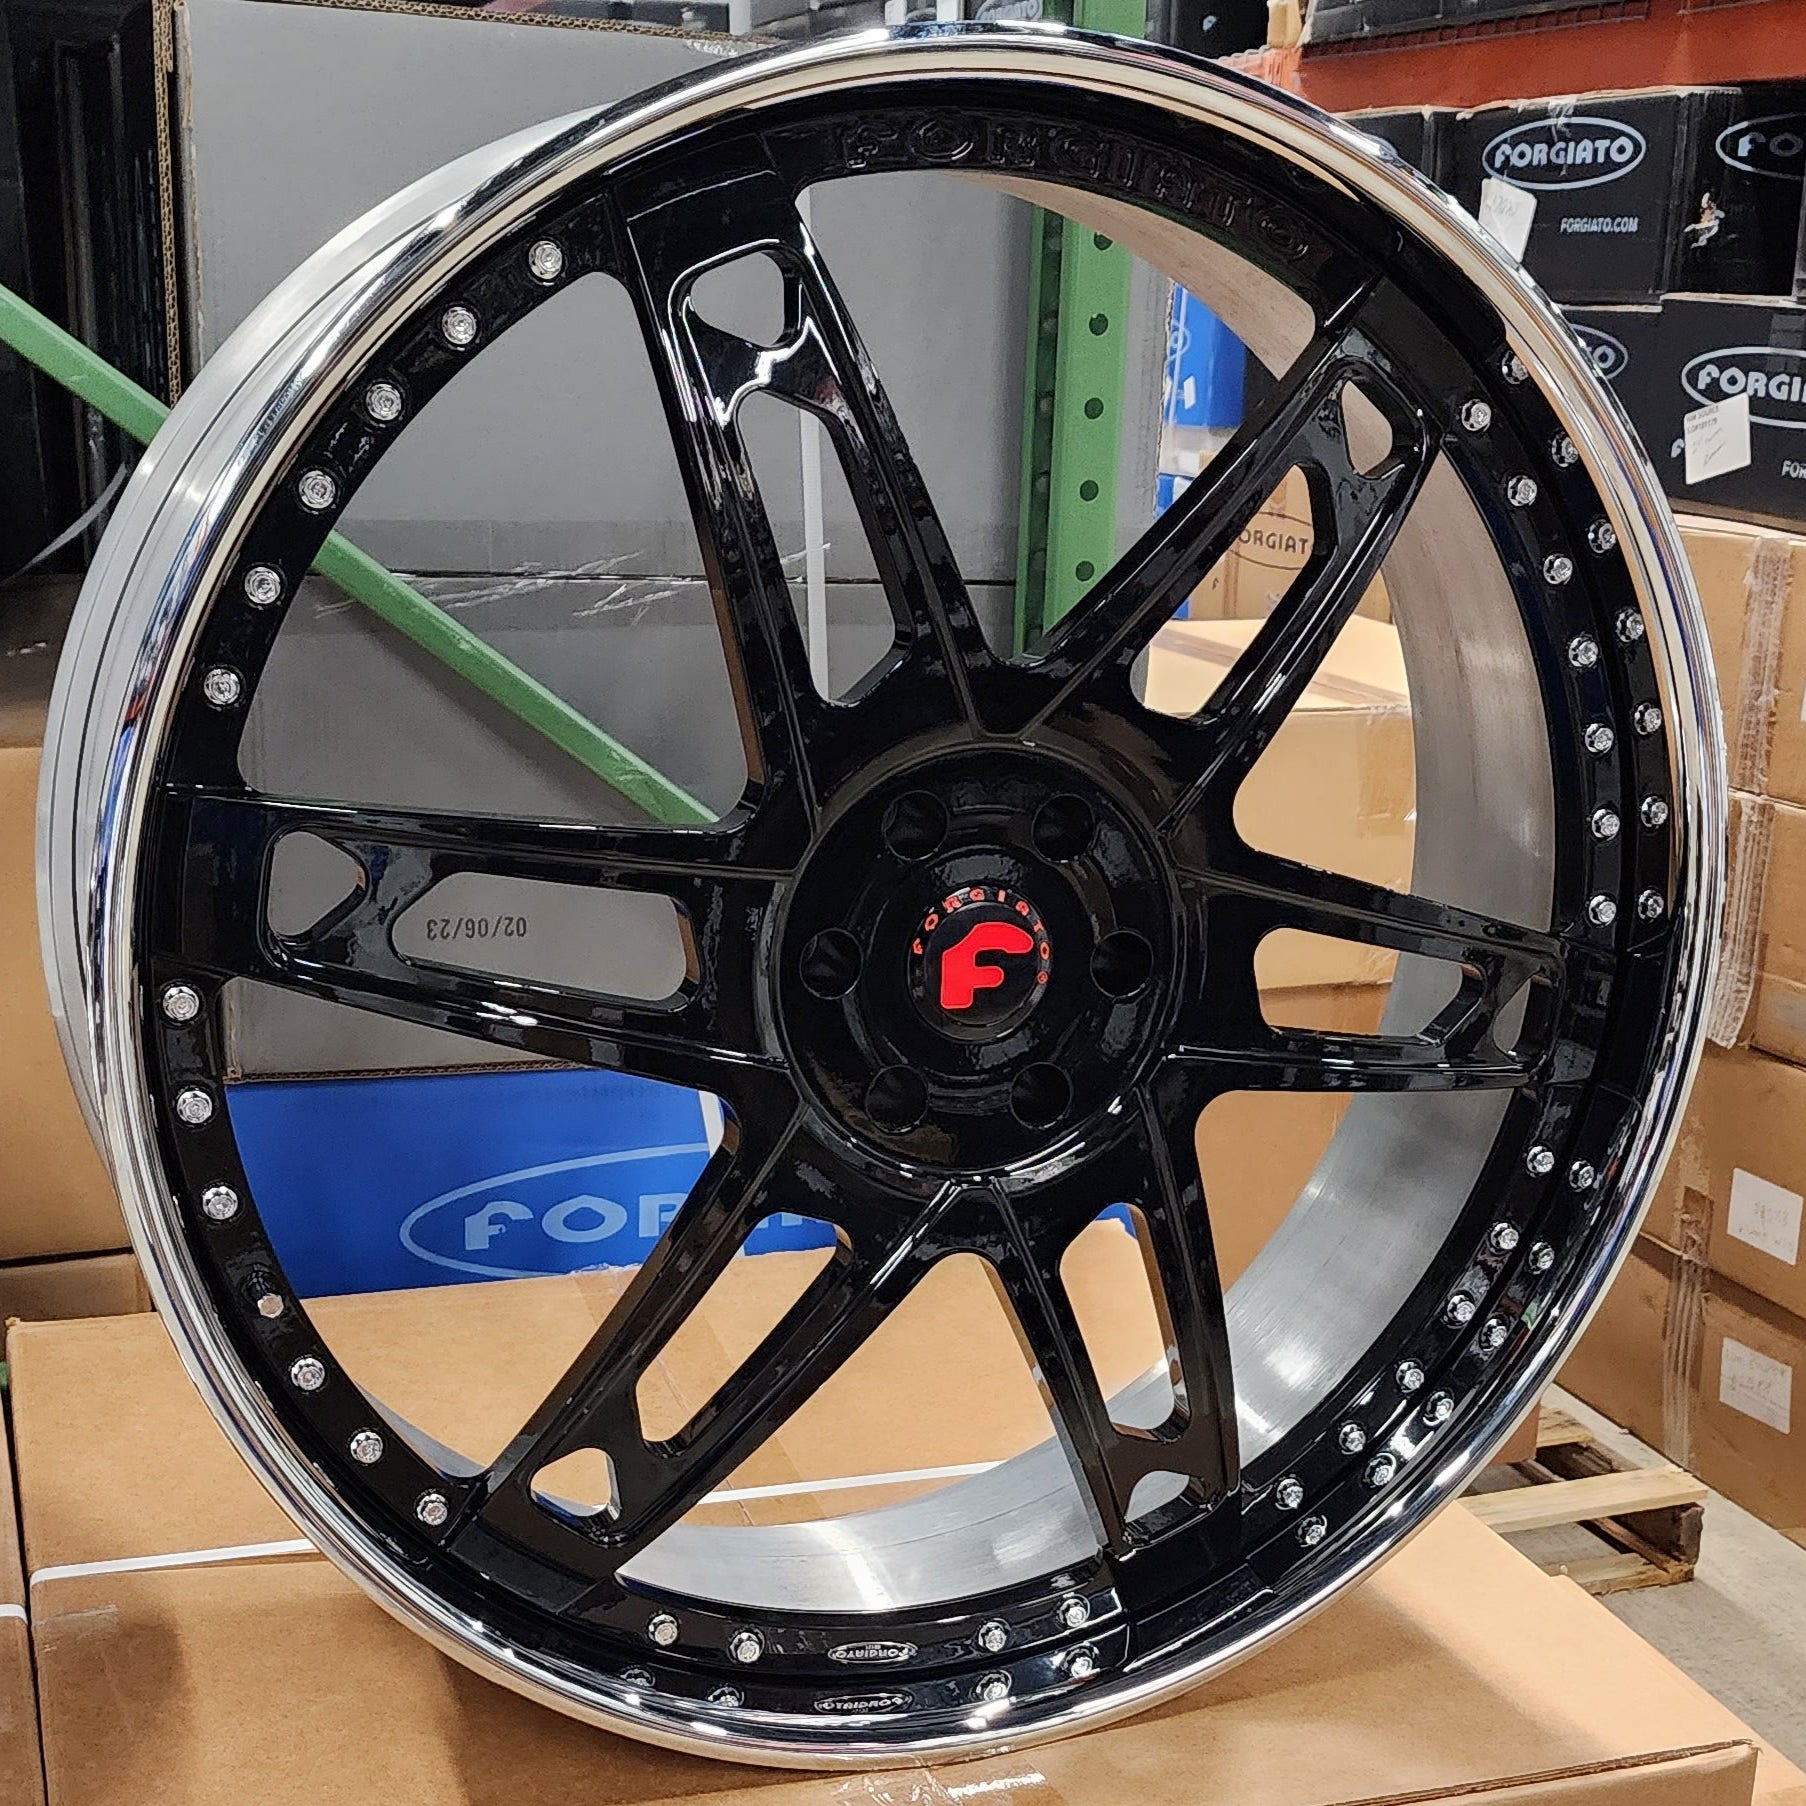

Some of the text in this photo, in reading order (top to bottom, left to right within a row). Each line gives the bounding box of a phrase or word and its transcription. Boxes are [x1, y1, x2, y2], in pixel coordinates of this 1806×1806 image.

[1494, 136, 1634, 168] FORGIATO
[1560, 216, 1639, 233] FORGIATO.COM
[1697, 363, 1806, 403] FORGI
[1239, 528, 1308, 554] ORGIAT
[426, 916, 527, 940] 02/06/23
[902, 885, 1051, 961] FORGIATO
[940, 921, 1035, 1010] F
